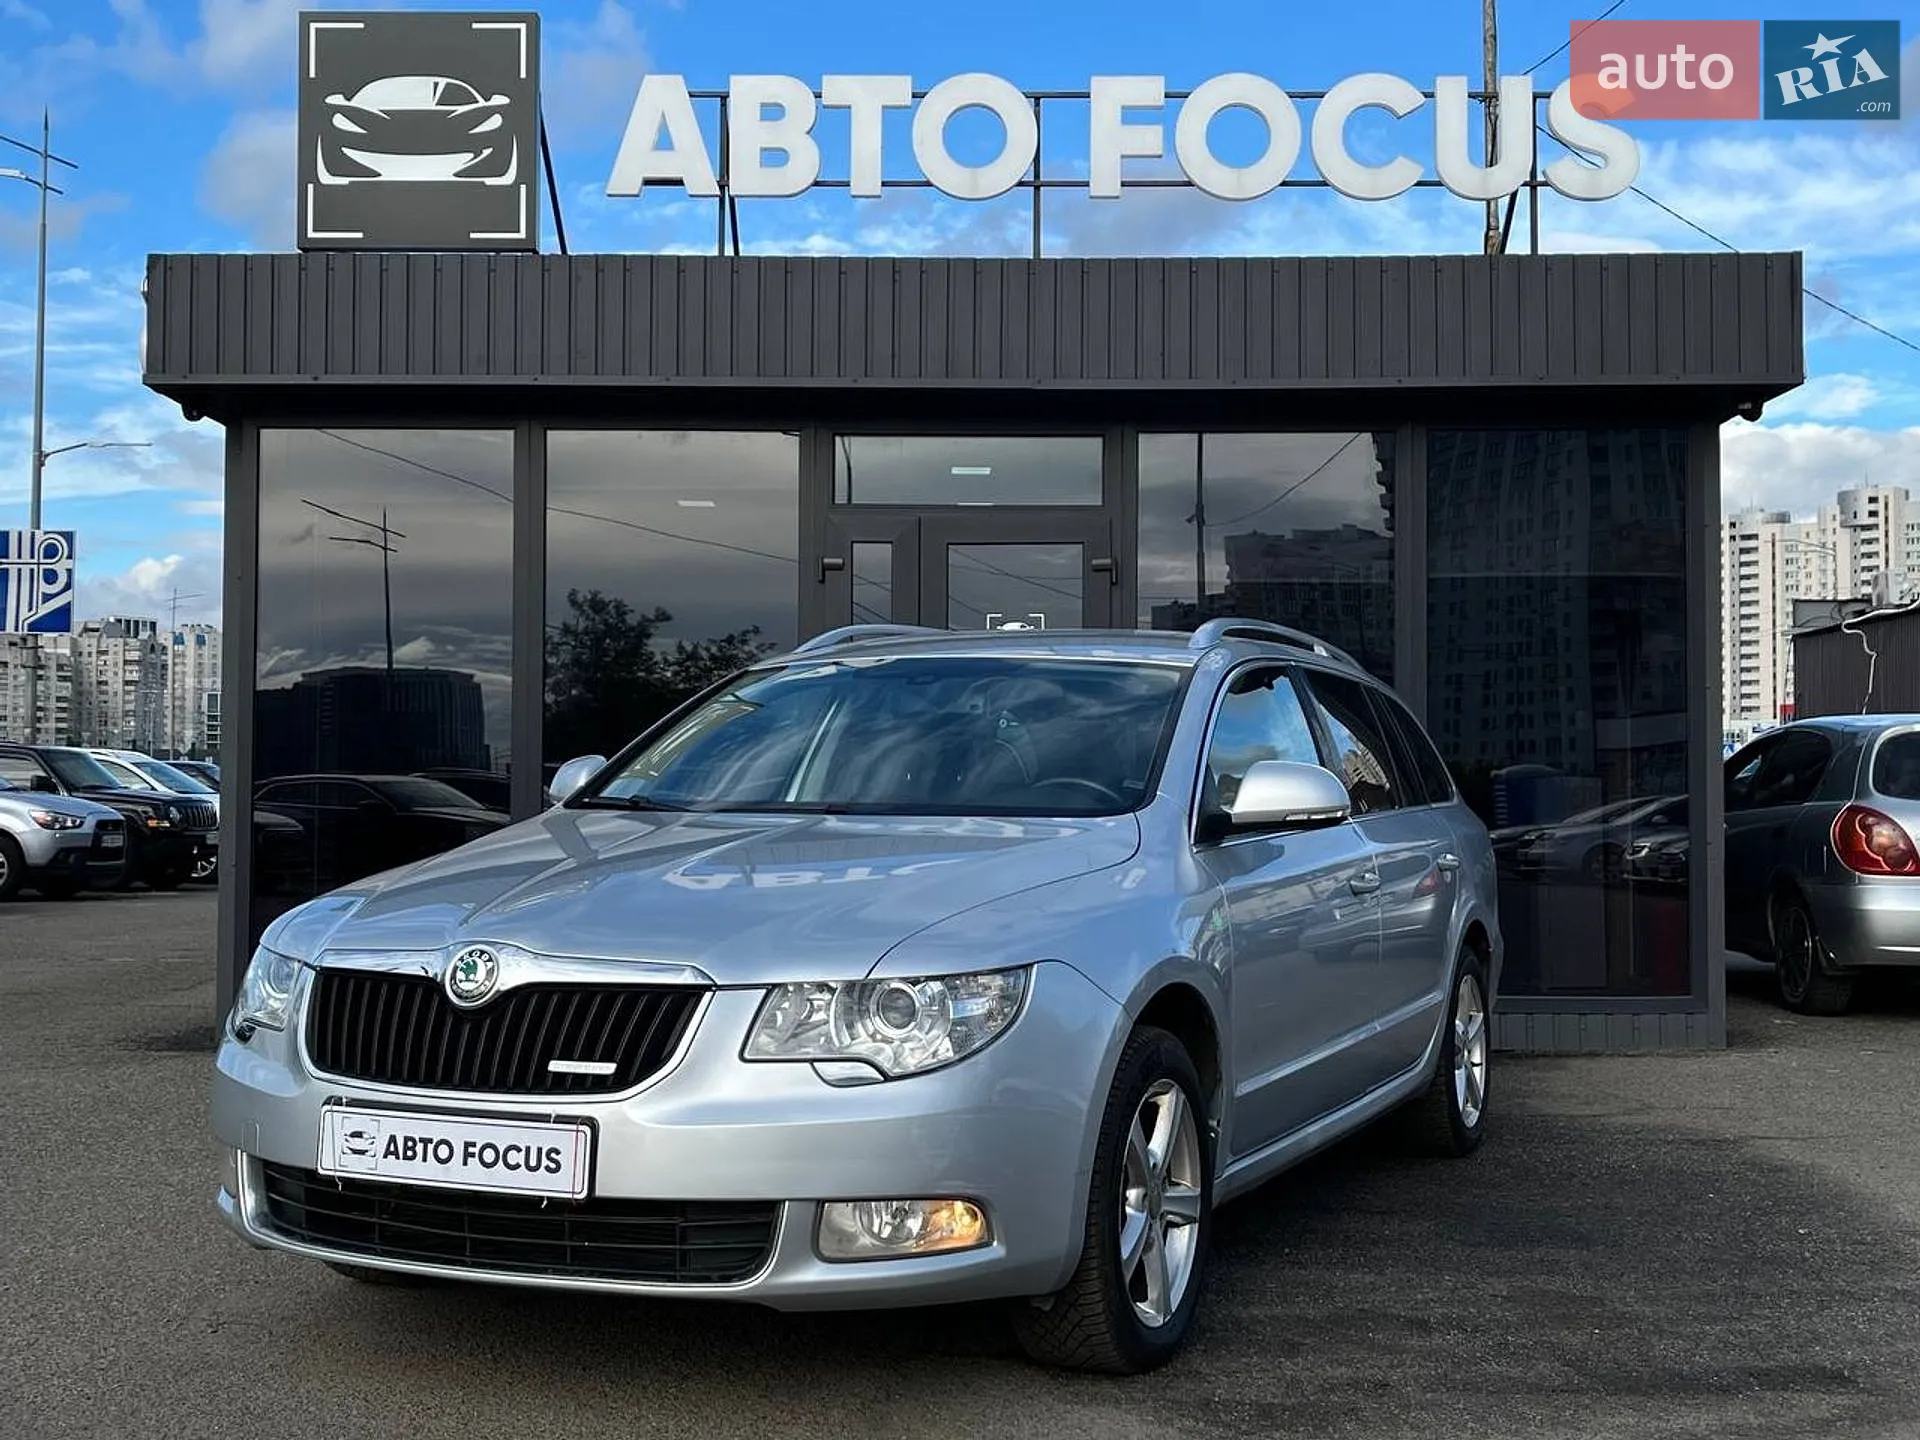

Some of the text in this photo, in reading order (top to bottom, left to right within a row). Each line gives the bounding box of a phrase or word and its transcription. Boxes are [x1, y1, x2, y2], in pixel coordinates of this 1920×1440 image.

[605, 72, 1640, 200] АВТО FOCUS
[382, 1134, 562, 1174] АВТО FOCUS
